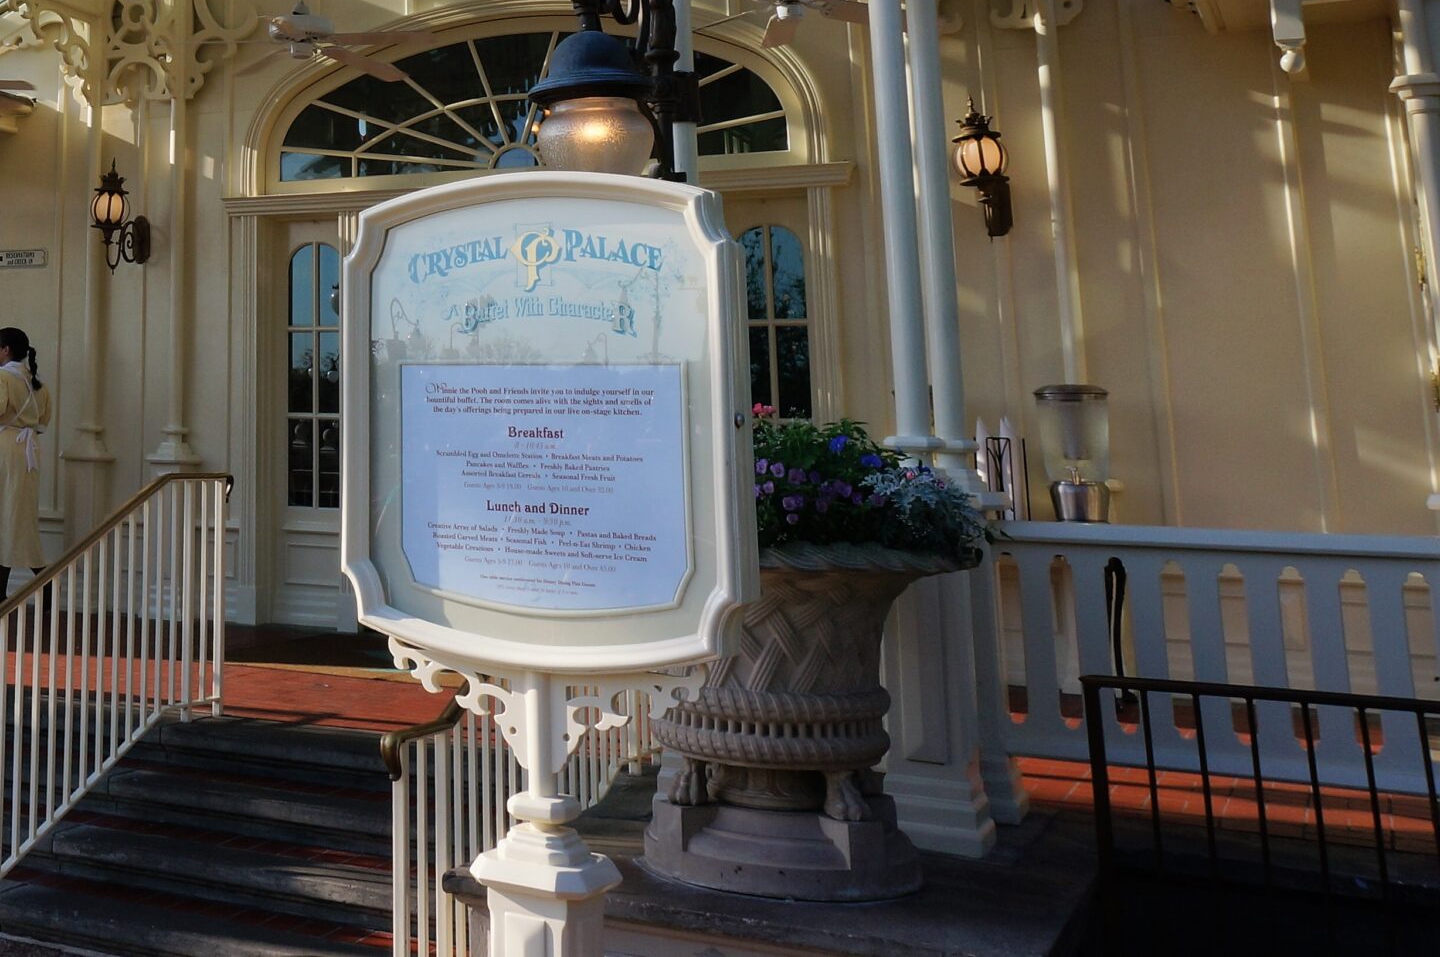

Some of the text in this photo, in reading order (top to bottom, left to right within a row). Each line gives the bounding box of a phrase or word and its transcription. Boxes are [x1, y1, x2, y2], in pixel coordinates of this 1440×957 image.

[408, 229, 662, 284] CRYSTAL PALACE
[460, 297, 509, 333] Buffet
[514, 297, 544, 317] With
[549, 297, 638, 338] CharacteR
[426, 383, 458, 394] Winnie
[552, 389, 564, 397] you
[574, 388, 600, 396] indulge
[602, 388, 631, 397] yourself
[426, 396, 456, 404] bountiful
[535, 397, 551, 405] alive
[553, 397, 570, 405] with
[582, 398, 603, 406] sights
[620, 398, 643, 406] smells
[644, 398, 652, 406] of
[444, 406, 461, 414] day's
[462, 406, 492, 414] offerings
[493, 407, 511, 415] being
[512, 407, 544, 416] prepared
[567, 407, 580, 415] live
[581, 408, 611, 416] on-stage
[508, 426, 564, 439] Breakfast
[468, 451, 479, 459] Egg
[616, 454, 644, 462] Potatoes
[466, 460, 493, 468] Pancakes
[507, 461, 529, 469] Waffles
[540, 463, 563, 471] Freshly
[564, 463, 584, 471] Baked
[488, 470, 517, 478] Breakfast
[551, 473, 580, 481] Seasonal
[600, 474, 616, 482] Fruit
[486, 500, 590, 516] Lunch and Dinner
[507, 527, 530, 535] Freshly
[550, 529, 566, 537] Soup
[577, 530, 597, 538] Pastas
[612, 532, 633, 540] Baked
[634, 533, 657, 541] Breads
[592, 541, 616, 550] Shrimp
[624, 543, 652, 552] Chicken
[544, 549, 566, 557] Sweets
[614, 553, 623, 561] Ice
[625, 554, 648, 562] Cream
